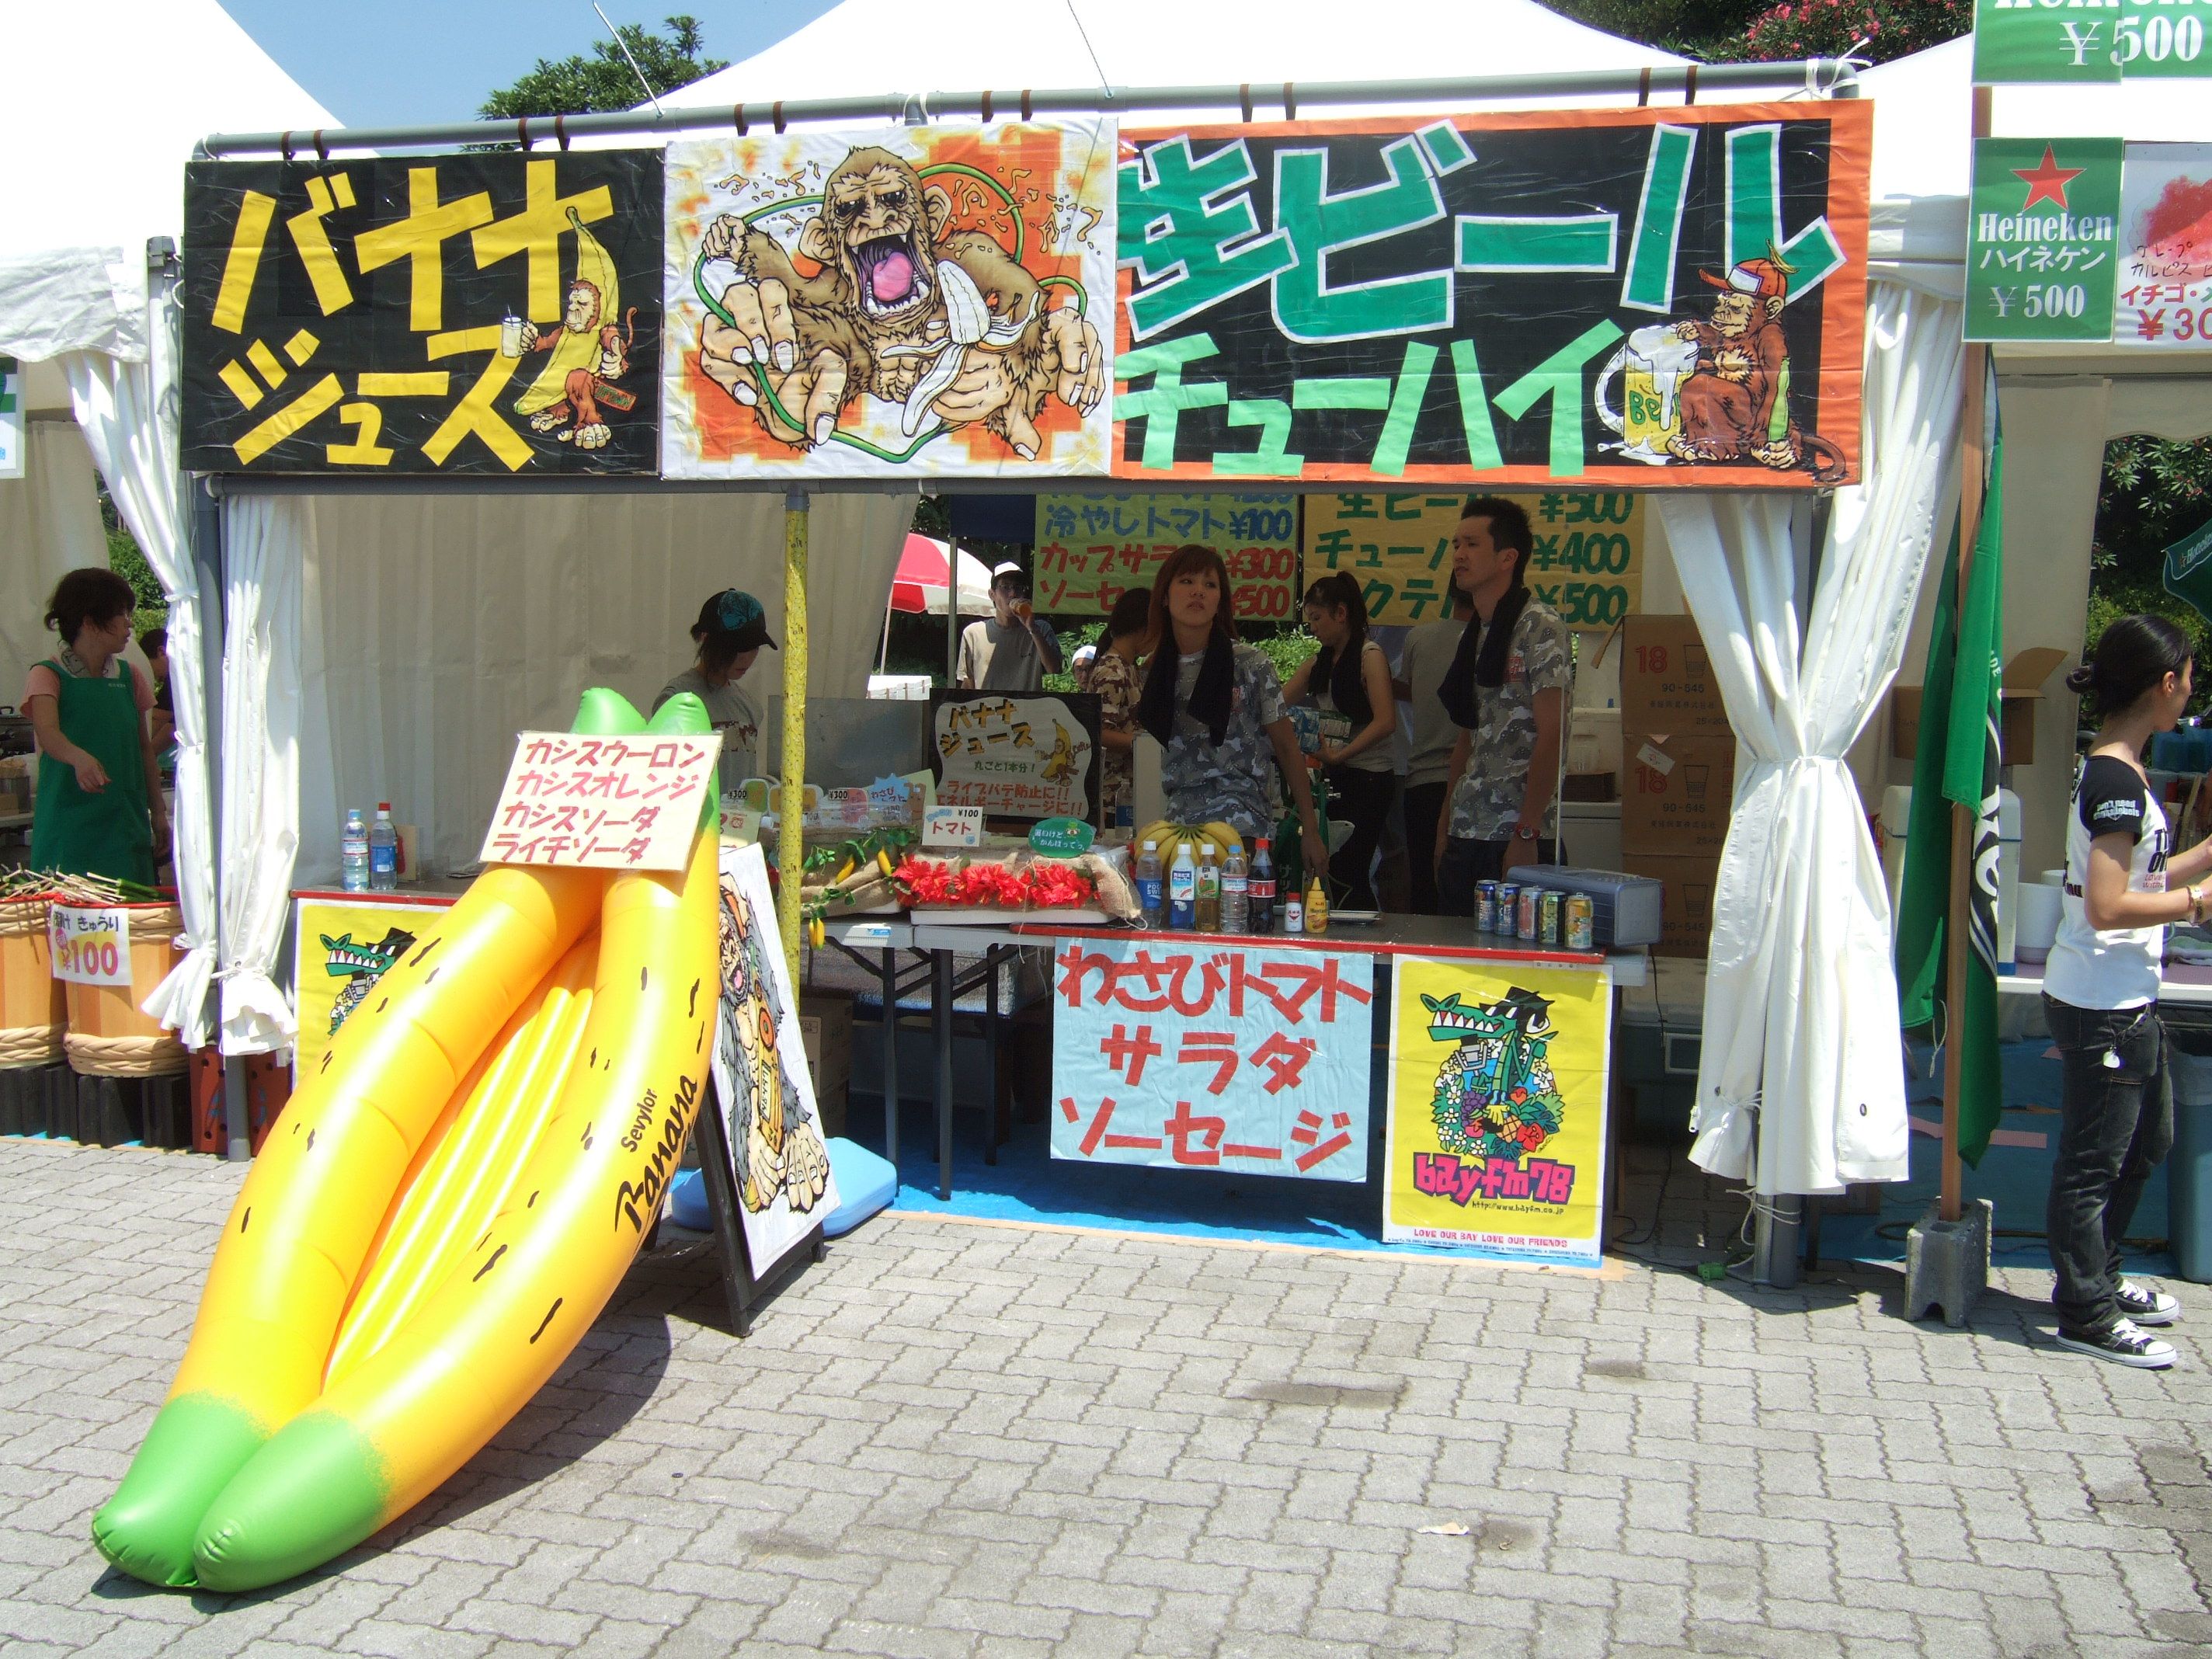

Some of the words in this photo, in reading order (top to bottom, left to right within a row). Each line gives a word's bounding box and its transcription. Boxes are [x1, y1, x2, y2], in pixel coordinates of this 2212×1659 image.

[1116, 119, 1845, 342] 生ビール
[1977, 211, 2113, 242] Heineken
[211, 159, 614, 334] バナナ
[1980, 245, 2106, 273] ハイネケン
[1988, 284, 2085, 318] ¥500
[218, 325, 534, 472] ジュース
[1113, 318, 1626, 477] チューハイ
[1225, 548, 1296, 580] ¥300
[1533, 533, 1631, 576] ¥400
[1634, 645, 1668, 674] 18
[949, 698, 1017, 731] バナナ
[526, 738, 706, 769] カシスウーロン
[939, 721, 1035, 759] ジュース
[515, 770, 700, 801] カシスオレンジ
[729, 789, 747, 799] ¥300
[829, 790, 848, 799] ¥300
[503, 801, 661, 836] カシスソーダ
[932, 821, 972, 835] トマト
[958, 809, 979, 818] ¥100
[492, 833, 652, 865] ライチソーダ
[78, 916, 119, 932] きゅうり
[1056, 945, 1372, 1025] わさびトマト
[1100, 1024, 1317, 1095] サラダ
[621, 1088, 658, 1153] Sevylor
[1059, 1096, 1352, 1173] ソーセージ
[1472, 1201, 1564, 1215] http://www.bayfm.co.jp
[1414, 1228, 1437, 1237] LOVE
[1440, 1231, 1457, 1240] OUR
[1481, 1234, 1504, 1243] LOVE
[1508, 1236, 1525, 1246] OUR
[1529, 1238, 1567, 1248] FRIENDS
